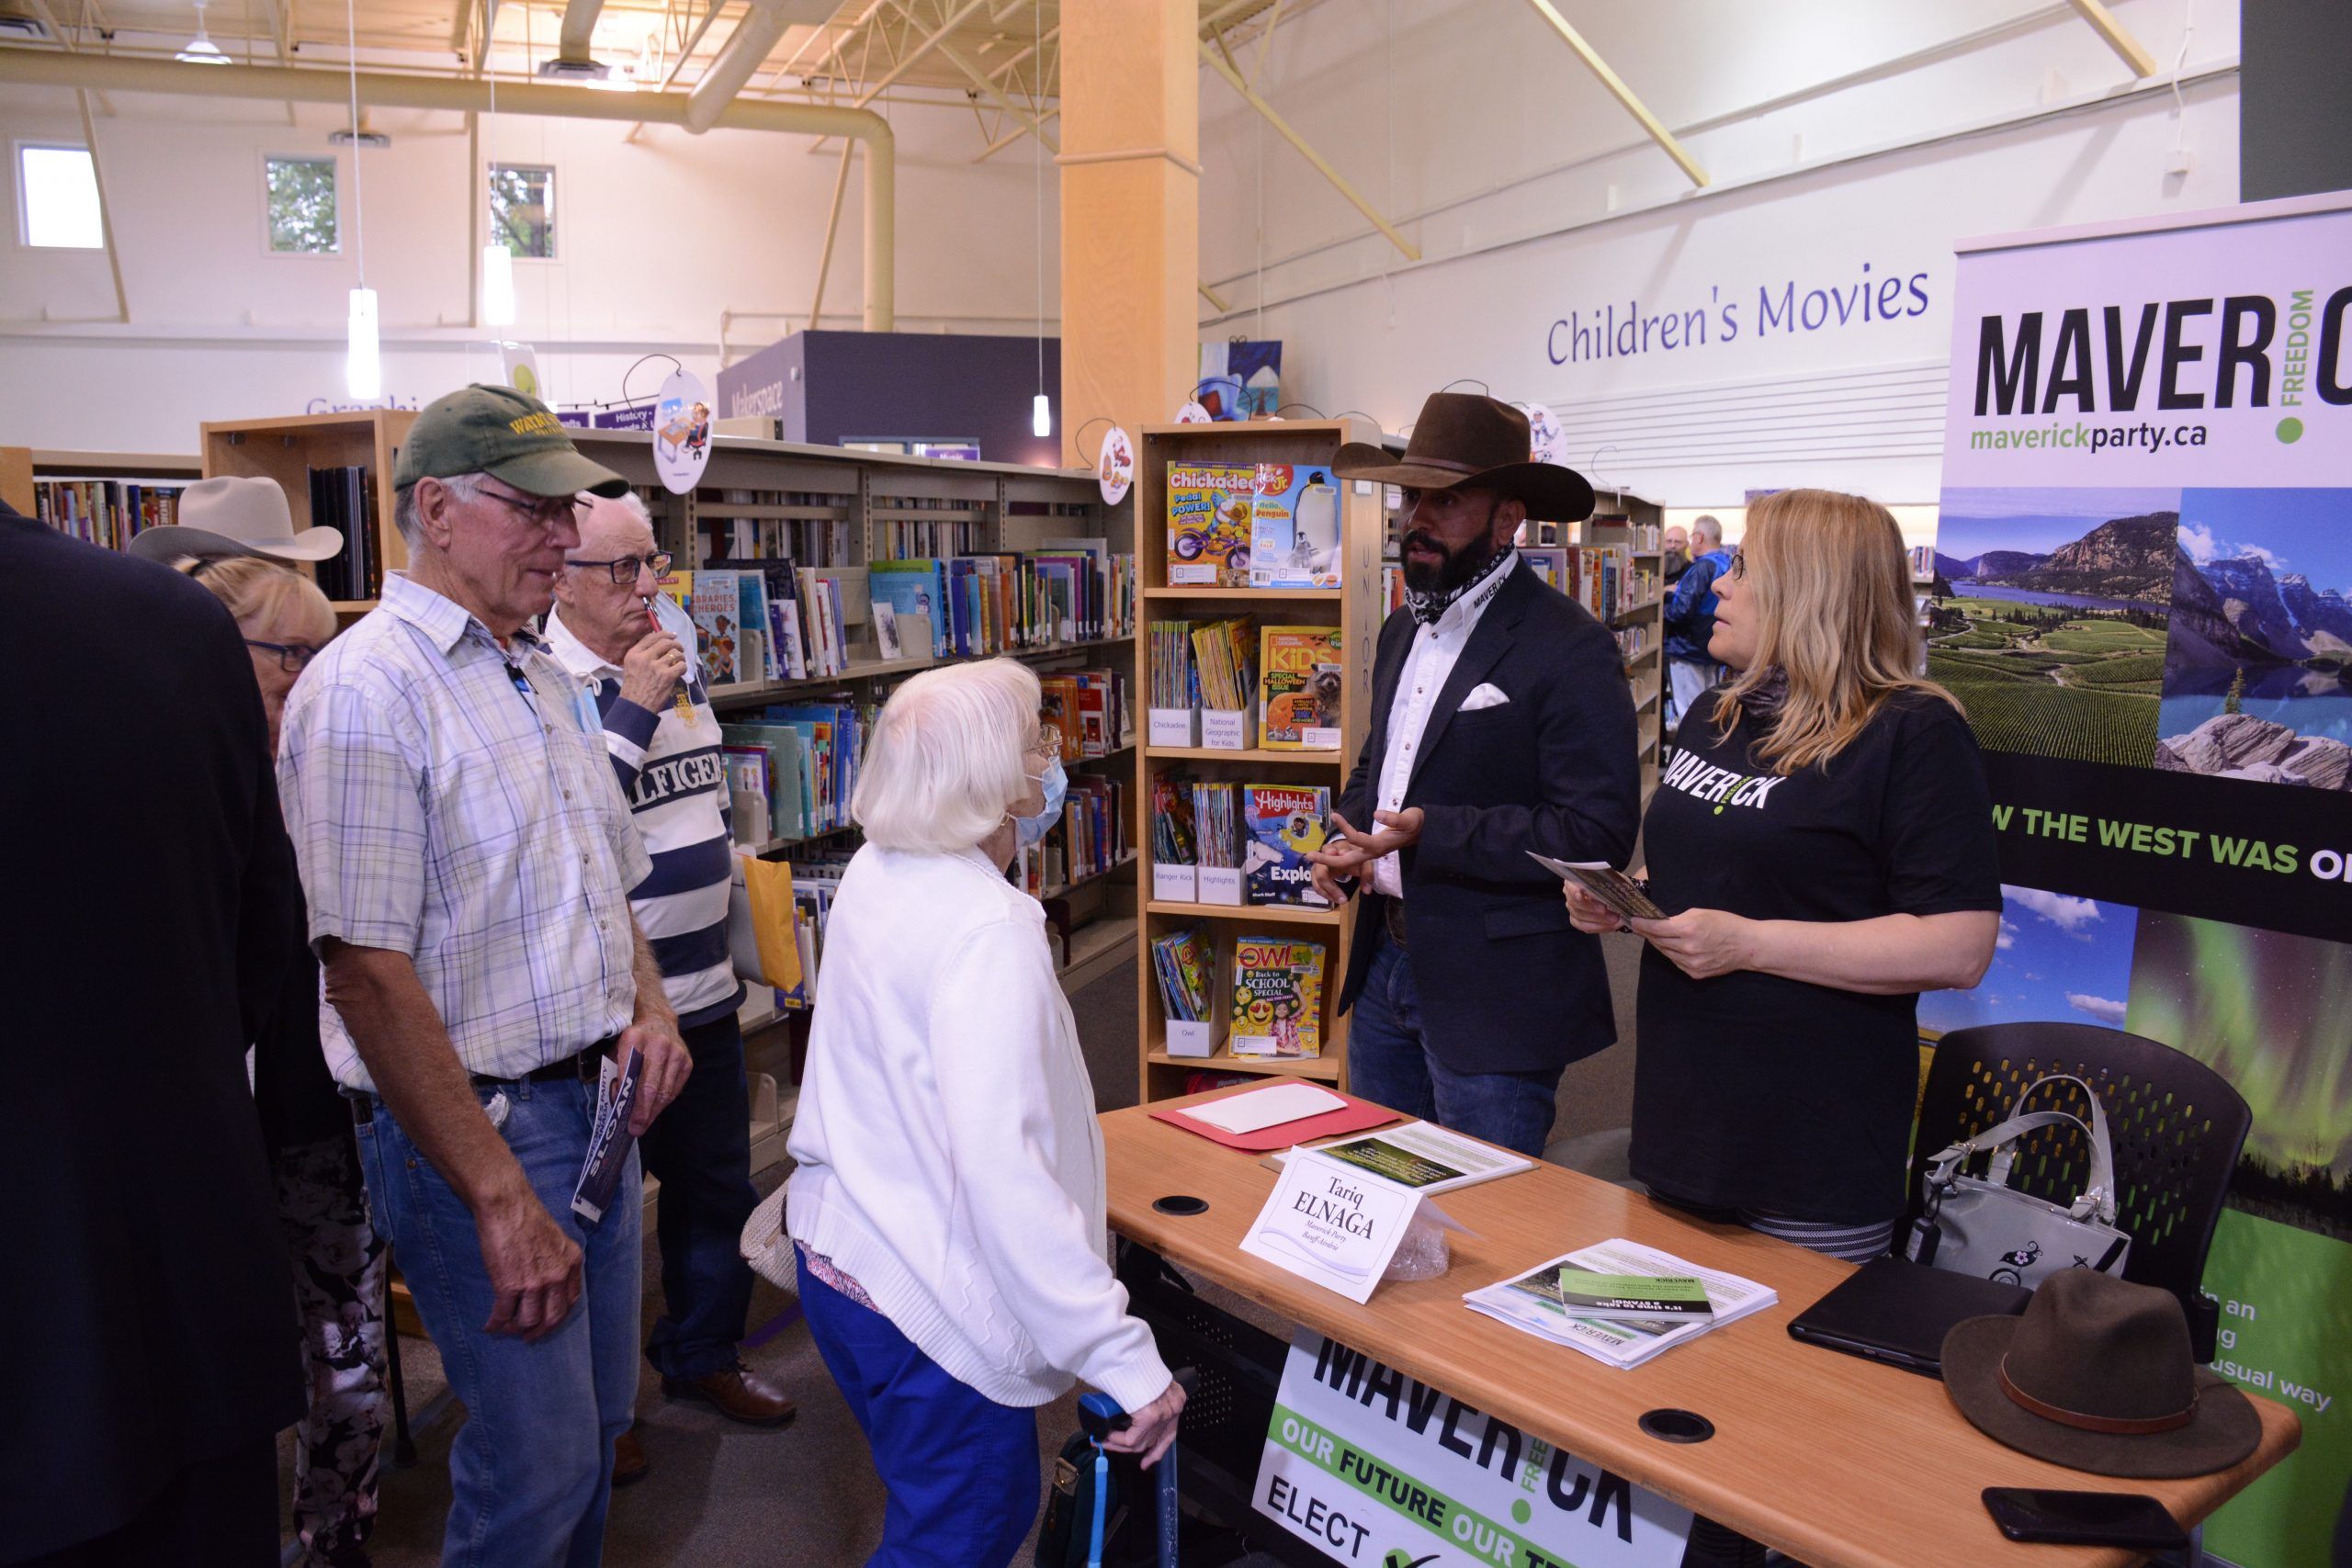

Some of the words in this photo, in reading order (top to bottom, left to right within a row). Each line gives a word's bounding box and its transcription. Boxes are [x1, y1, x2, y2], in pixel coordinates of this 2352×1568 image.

[1547, 286, 1738, 366] Children's
[1758, 263, 1928, 337] Movies
[2280, 288, 2313, 407] FREEDOM
[616, 412, 647, 423] History
[1971, 422, 2207, 454] maverickparty.ca
[1174, 491, 1202, 503] Pedal
[1171, 502, 1211, 516] POWER!
[1256, 509, 1290, 519] Penguin
[698, 604, 735, 613] HEROES
[1362, 544, 1371, 694] UNIOR
[1153, 721, 1186, 729] Chickadee
[1209, 717, 1235, 727] National
[1205, 728, 1240, 739] Geographic
[1211, 739, 1220, 747] for
[1221, 739, 1235, 747] Kids
[1255, 790, 1314, 812] Highlights
[2022, 808, 2088, 843] THE
[2098, 818, 2200, 859] WEST
[2209, 834, 2298, 874] WAS
[1156, 873, 1177, 882] Ranger
[1180, 874, 1193, 882] Rick
[1204, 875, 1236, 885] Highlights
[1238, 941, 1300, 969] OWL
[1245, 978, 1291, 989] SCHOOL
[1182, 1028, 1194, 1037] Owl
[590, 1076, 634, 1179] SLOAN
[1327, 1176, 1364, 1210] Tariq
[1292, 1190, 1374, 1240] ELNAGA
[1305, 1220, 1331, 1235] Maverick
[1330, 1230, 1347, 1243] Party
[2225, 1299, 2256, 1321] an
[2279, 1380, 2332, 1412] way
[1283, 1417, 1334, 1463] OUR
[1339, 1449, 1447, 1529] FUTURE
[1452, 1512, 1516, 1567] OUR
[1267, 1474, 1371, 1559] ELECT
